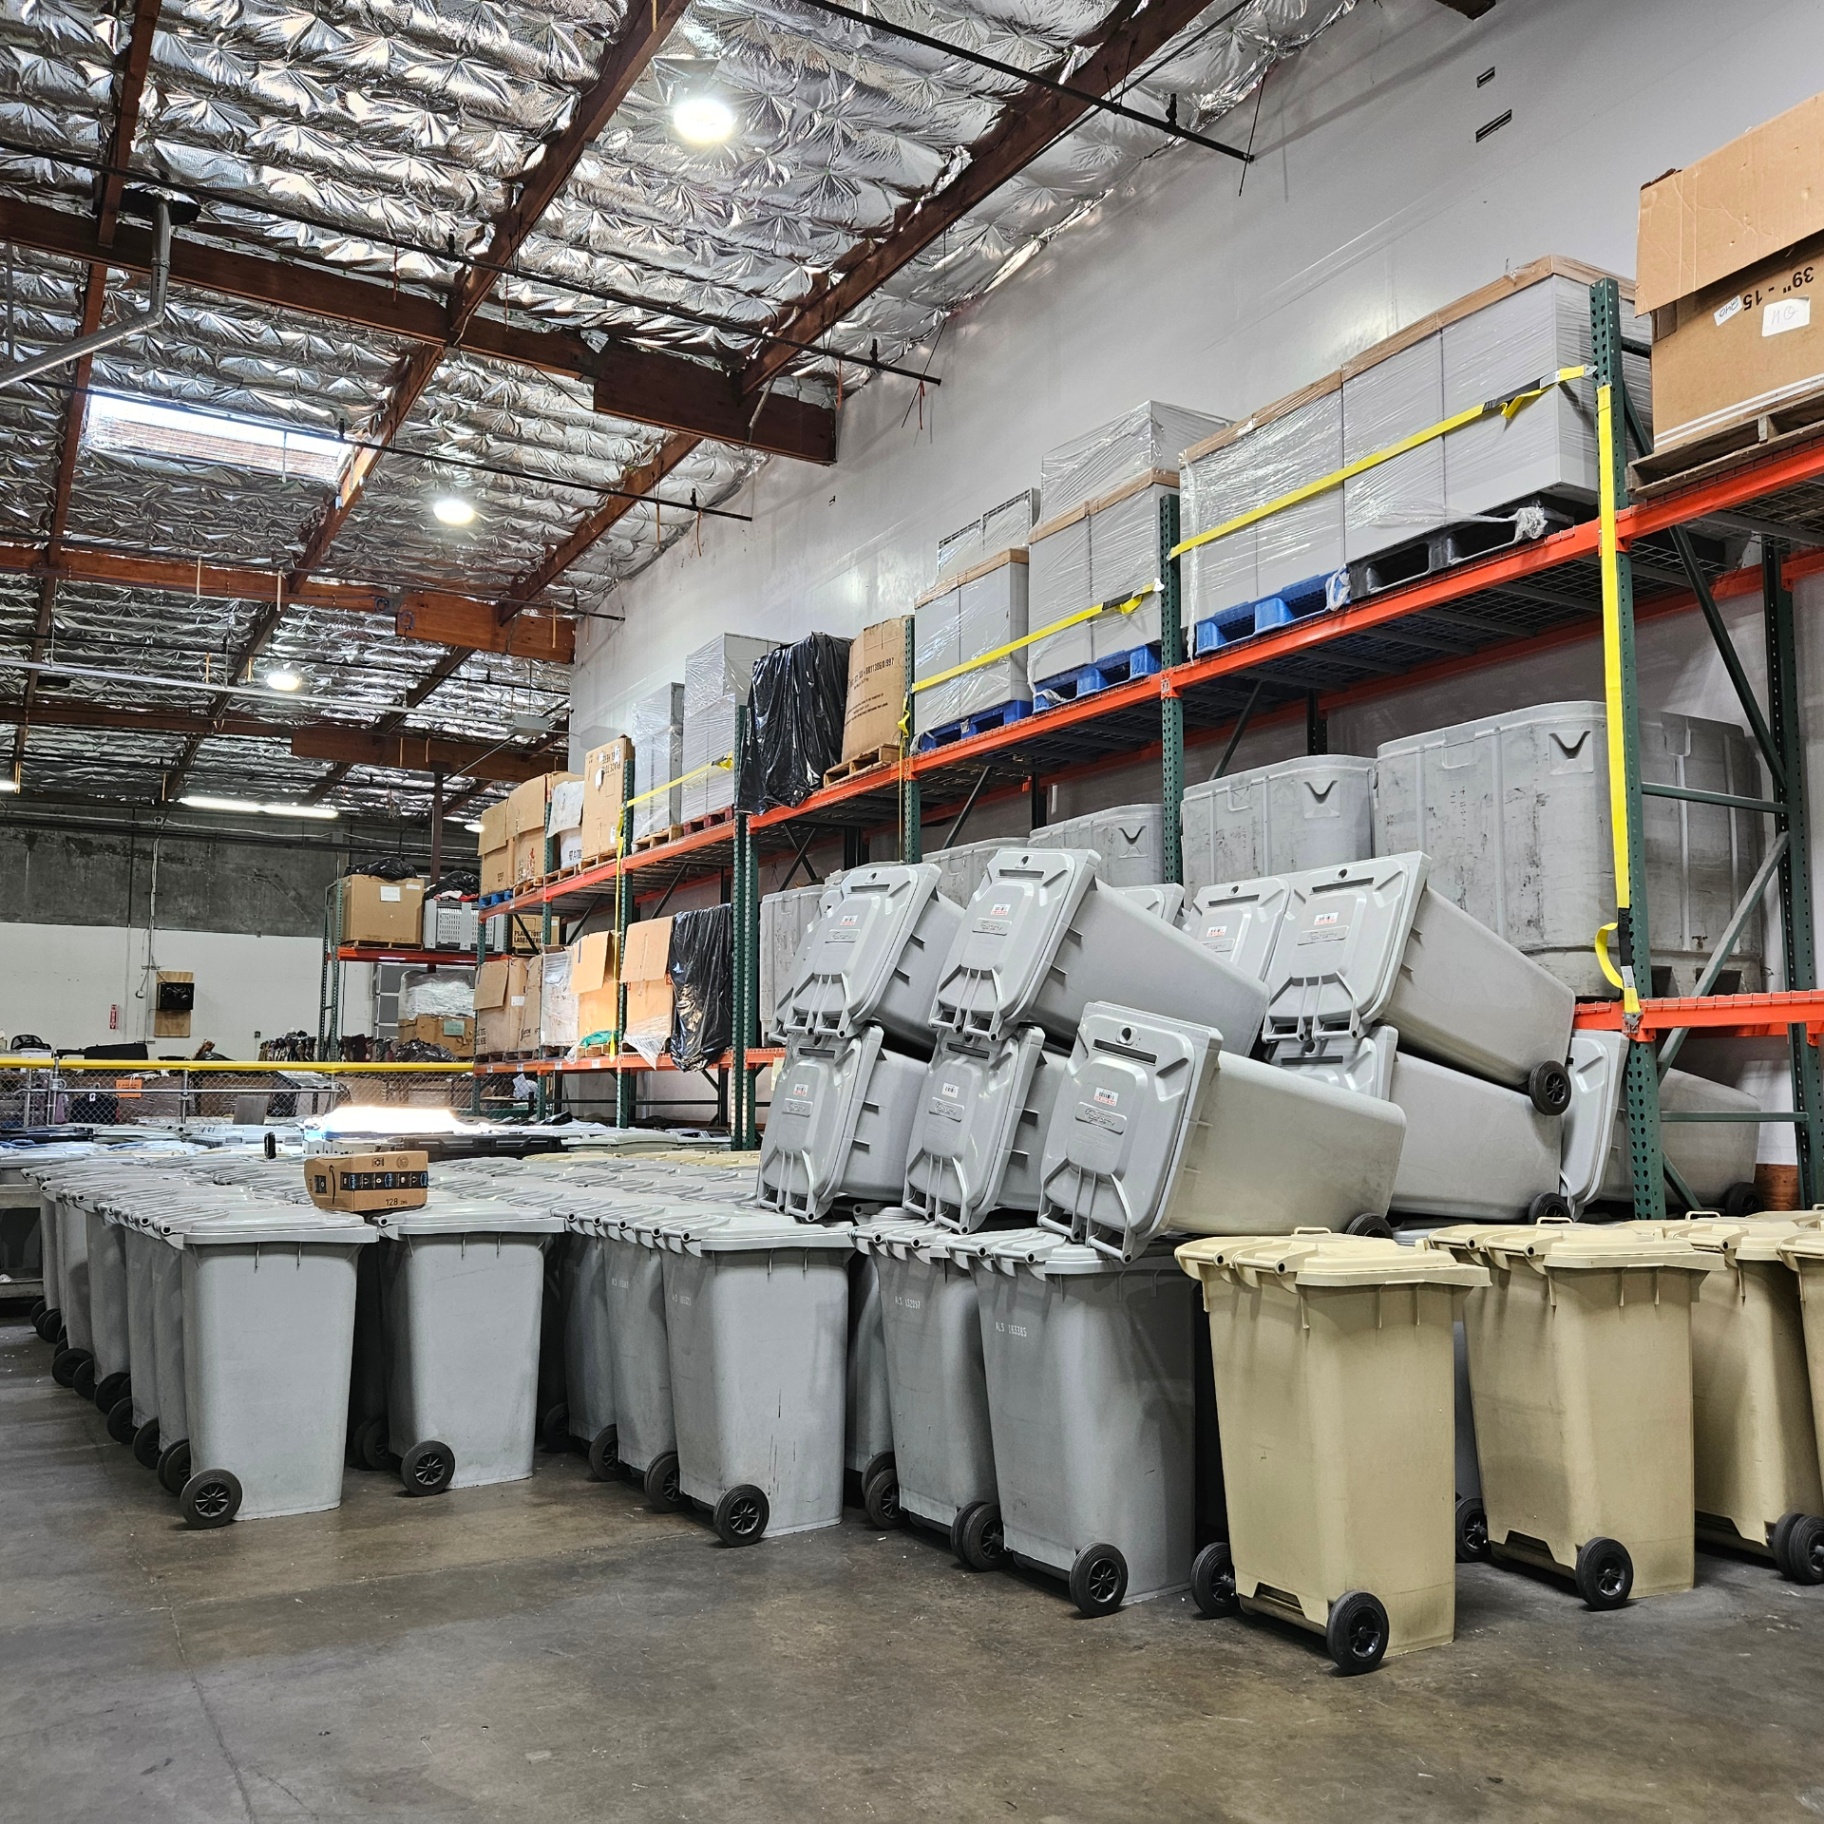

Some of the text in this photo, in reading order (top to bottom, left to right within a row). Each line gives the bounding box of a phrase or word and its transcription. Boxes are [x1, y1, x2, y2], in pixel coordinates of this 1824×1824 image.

[1783, 266, 1814, 294] 39"
[1743, 290, 1763, 311] 15
[385, 1197, 398, 1206] 128
